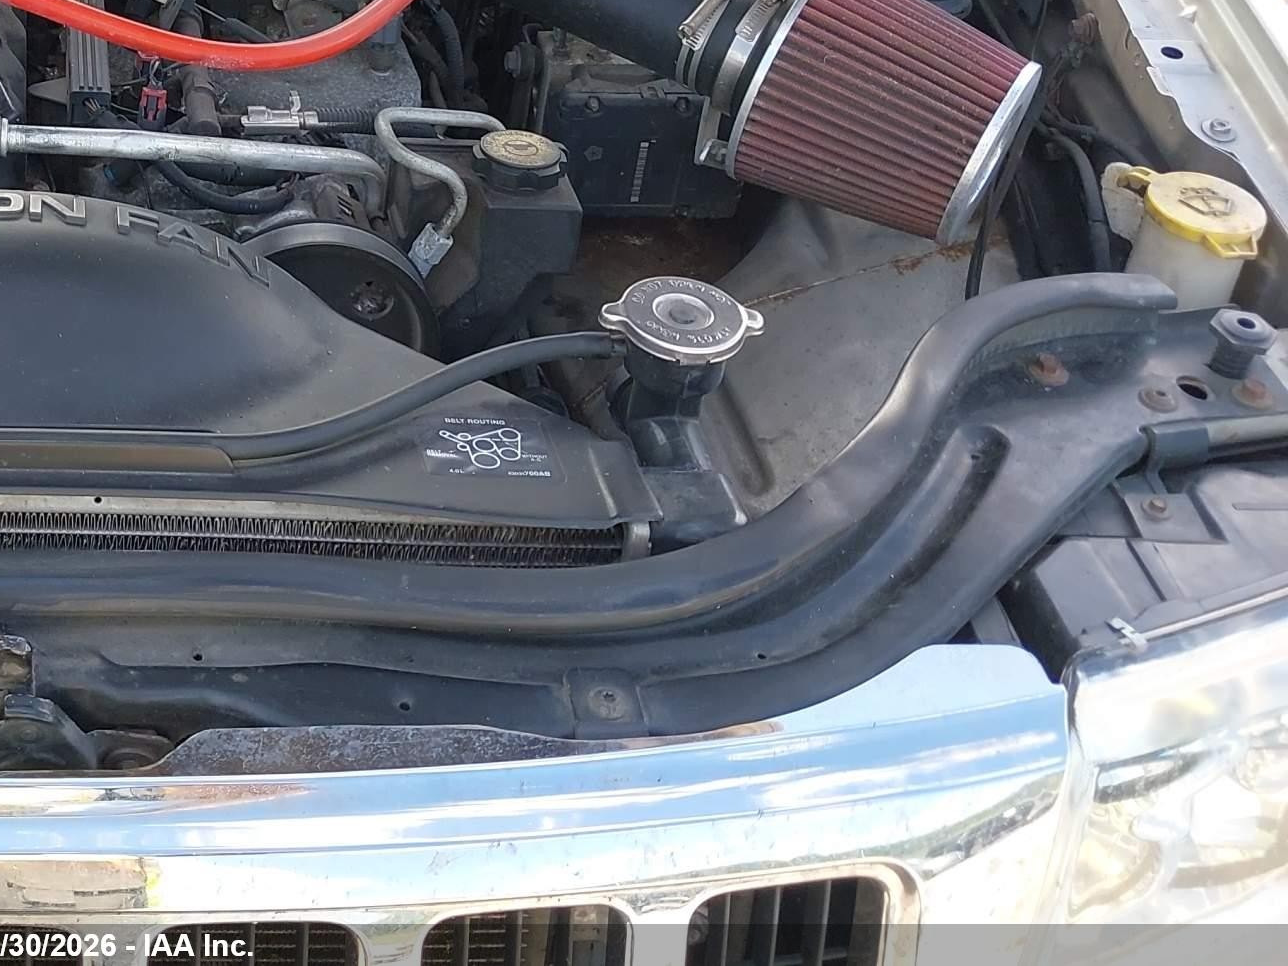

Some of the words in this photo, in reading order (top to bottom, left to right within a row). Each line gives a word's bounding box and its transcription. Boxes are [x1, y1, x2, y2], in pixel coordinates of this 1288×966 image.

[117, 205, 269, 288] FAN
[444, 417, 464, 425] BELT
[467, 417, 506, 426] ROUTING
